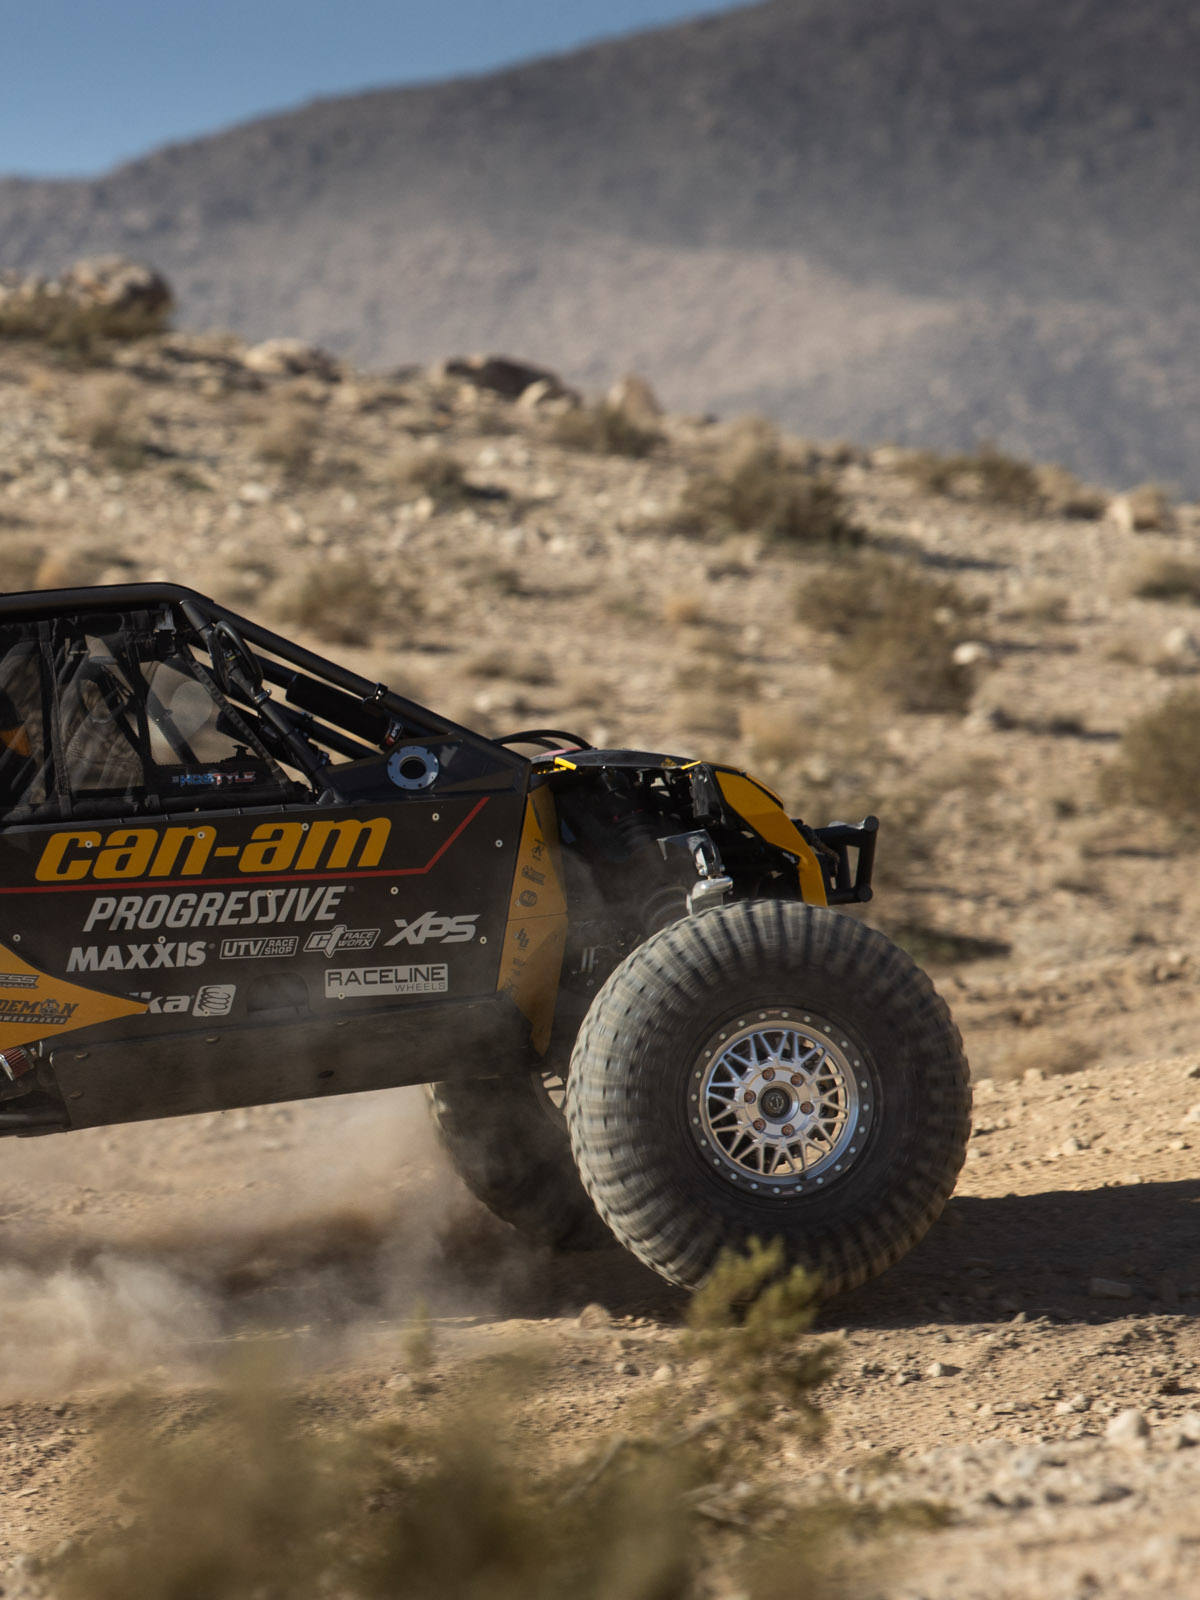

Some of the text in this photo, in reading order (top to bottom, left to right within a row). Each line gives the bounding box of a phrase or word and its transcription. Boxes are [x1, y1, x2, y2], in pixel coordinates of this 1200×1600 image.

[34, 817, 393, 882] can-am
[82, 886, 347, 932] PROGRESSIVE
[343, 931, 376, 940] RACE
[383, 911, 481, 946] XPS
[224, 940, 265, 957] UTV
[264, 945, 292, 955] SHOP
[268, 938, 295, 948] RACE
[338, 938, 373, 947] WORX
[66, 940, 206, 972] MAXXIS
[327, 965, 446, 987] RACELINE
[394, 982, 446, 992] WHEELS
